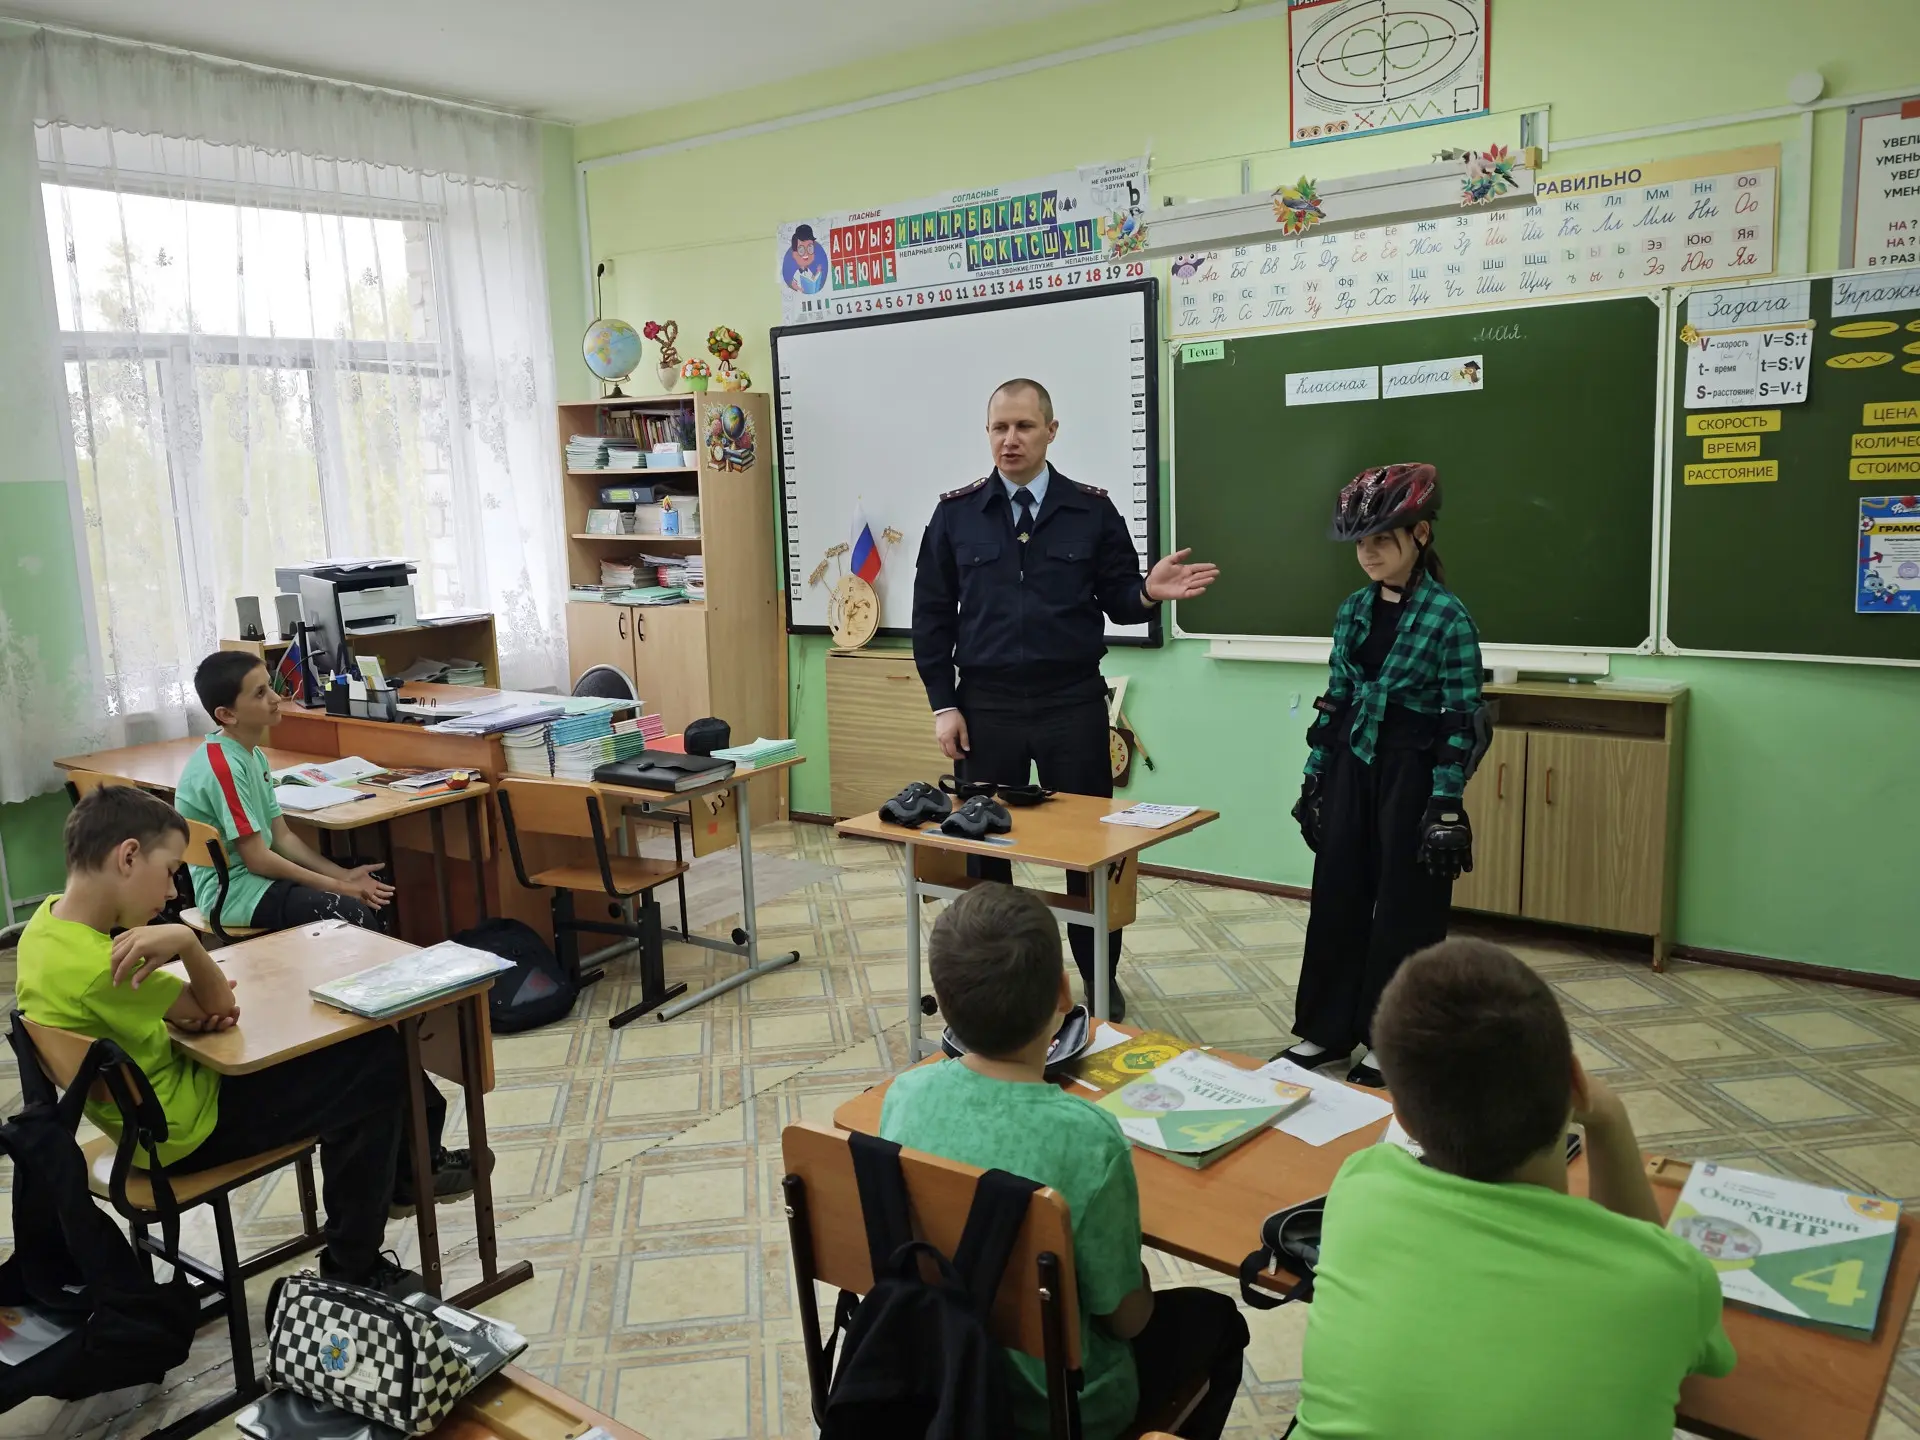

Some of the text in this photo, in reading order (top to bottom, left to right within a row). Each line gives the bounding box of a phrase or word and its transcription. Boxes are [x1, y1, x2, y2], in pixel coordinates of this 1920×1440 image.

[1100, 172, 1139, 183] ОБОЗНАЧАЮТ
[1536, 169, 1642, 197] РАВИЛЬНО
[952, 188, 998, 203] СОГЛАСНЫЕ
[849, 210, 881, 222] ГЛАСНЫЕ
[1207, 177, 1756, 260] Аа Бб Вв Жж Зз Ии Кк Лл Мм Нн Оо
[833, 235, 840, 253] А
[845, 232, 852, 249] О
[858, 229, 865, 249] У
[870, 227, 880, 246] Ы
[885, 225, 892, 245] Э
[898, 218, 905, 242] Й
[912, 221, 919, 240] Н
[925, 217, 934, 238] М
[940, 215, 948, 235] Л
[954, 213, 961, 233] Р
[969, 210, 976, 231] Б
[983, 208, 991, 228] В
[999, 205, 1005, 226] Г
[1013, 202, 1022, 224] Д
[1029, 200, 1036, 221] З
[1042, 197, 1055, 219] Ж
[1889, 221, 1907, 231] НА
[969, 244, 977, 264] П
[984, 242, 993, 262] Ф
[1000, 240, 1008, 260] К
[1015, 237, 1022, 258] Т
[1031, 235, 1039, 255] С
[1044, 232, 1058, 253] Ш
[1063, 230, 1072, 251] Х
[1079, 226, 1089, 249] Ц
[1199, 264, 1219, 283] Аа
[1318, 250, 1339, 272] Дд
[1407, 237, 1443, 256] Жж
[1454, 232, 1471, 255] Зз
[1558, 217, 1582, 236] Кк
[1592, 212, 1623, 232] Лл
[1633, 205, 1676, 227] Мм
[1688, 198, 1719, 220] Нн
[1735, 192, 1758, 213] Оо
[1887, 237, 1904, 248] НА
[900, 242, 963, 258] НЕПАРНЫЕ ЗВОНКИЕ
[1065, 255, 1099, 265] НЕПАРНЫЕ
[1183, 297, 1194, 305] Пп
[1213, 293, 1224, 303] Рр
[1242, 290, 1252, 298] Сс
[1275, 286, 1285, 295] Тт
[1306, 282, 1318, 292] Уу
[1339, 278, 1354, 288] Фф
[1376, 273, 1389, 283] Хх
[1411, 269, 1426, 279] Цц
[1448, 264, 1460, 274] Чч
[1483, 260, 1504, 270] Шш
[1524, 254, 1547, 265] Щщ
[1647, 240, 1662, 250] Ээ
[1687, 235, 1712, 245] Юю
[1737, 229, 1753, 240] Яя
[1869, 253, 1915, 266] В РАЗ
[834, 256, 893, 284] Я Ё Ю И Е
[976, 267, 1000, 277] ПАРНЫЕ
[836, 262, 1144, 314] 0 1 2 3 4 5 6 7 8 9 10 11 12 13 14 15 16 17 18 19 20
[1179, 246, 1757, 329] Пп Рр Сс Тт Уу Фф Хх Цц Чч Шш Щщ Ээ Юю Яя
[1708, 294, 1790, 322] Задача
[1188, 348, 1218, 358] Тема:
[1715, 365, 1736, 374] время
[1296, 365, 1451, 395] Классная работа
[1874, 407, 1918, 422] ЦЕНА
[1699, 416, 1767, 430] СКОРОСТЬ
[1708, 442, 1756, 454] ВРЕМЯ
[1688, 466, 1774, 480] РАССТОЯНИЕ
[1857, 462, 1920, 474] СТОИМО
[1700, 1187, 1860, 1233] Окружающий
[1790, 1260, 1867, 1307] 4
